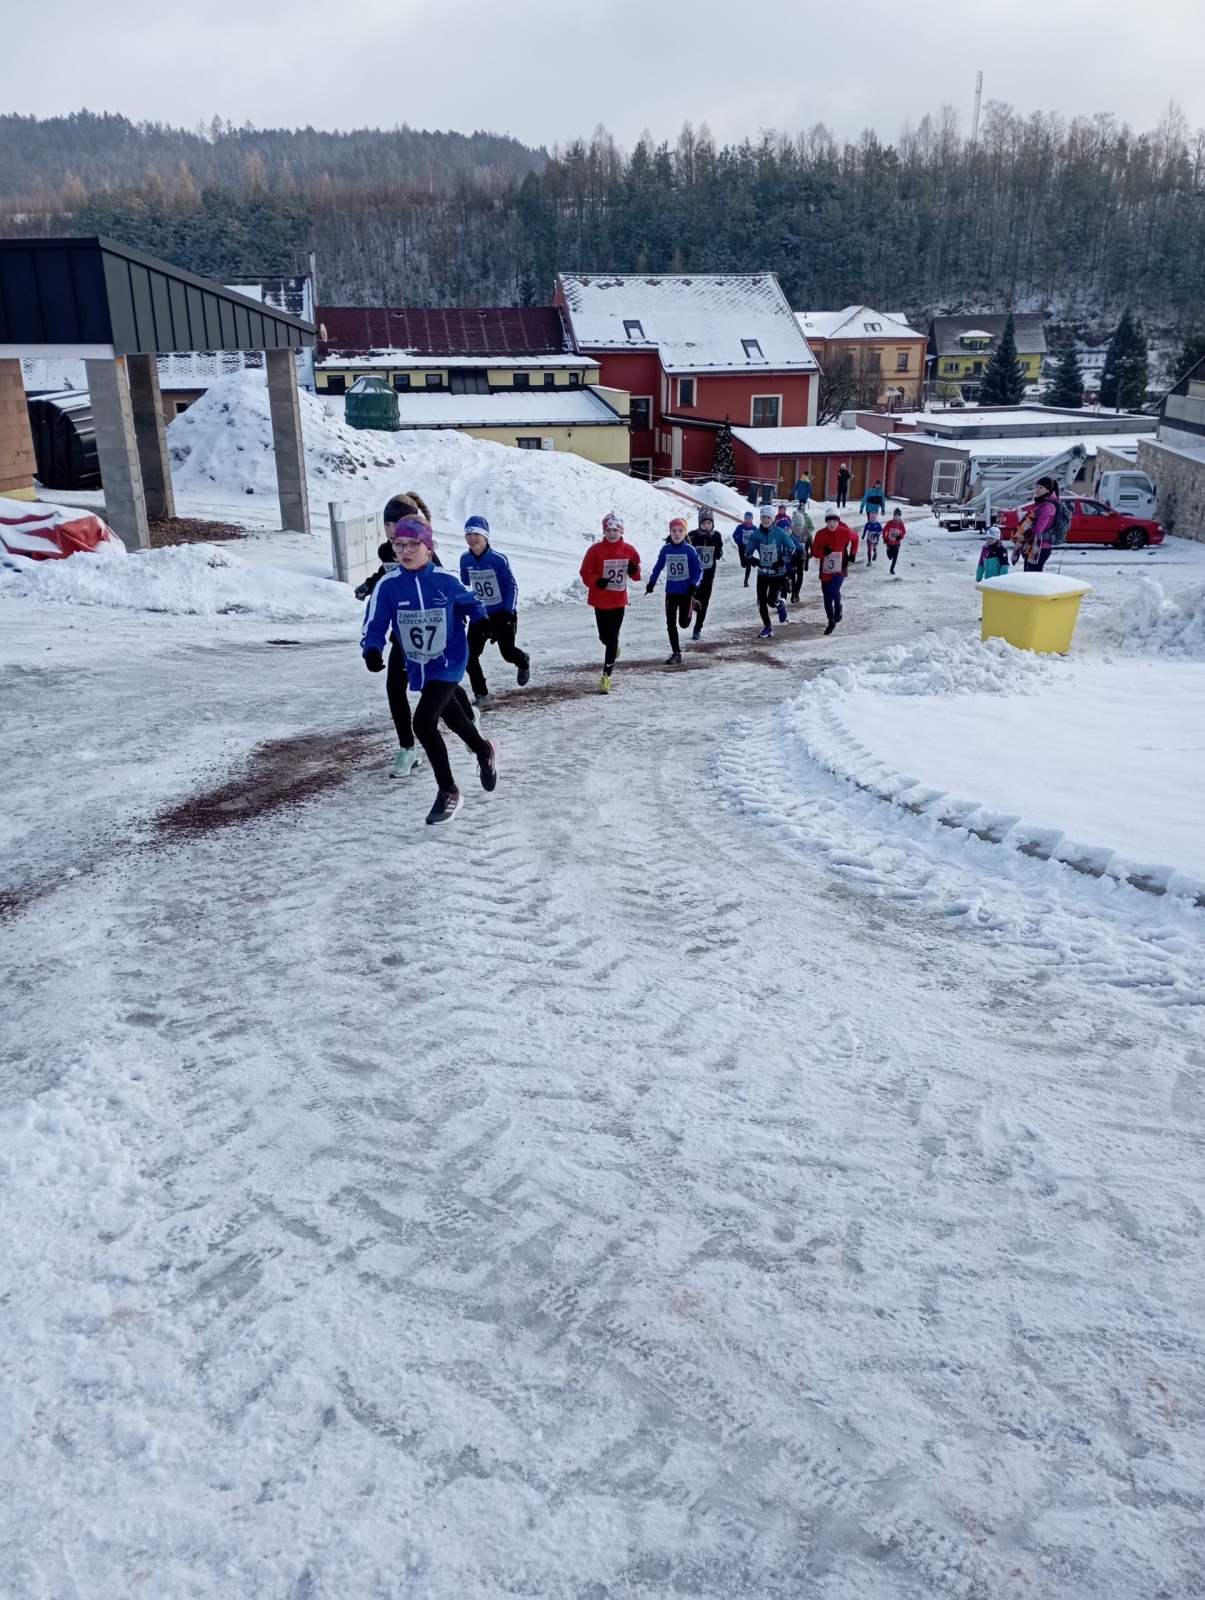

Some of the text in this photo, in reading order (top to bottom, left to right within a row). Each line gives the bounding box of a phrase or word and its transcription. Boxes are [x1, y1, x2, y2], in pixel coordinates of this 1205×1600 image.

[762, 551, 773, 562] 27
[670, 562, 684, 576] 69
[828, 559, 835, 570] 3
[607, 569, 624, 584] 25
[474, 581, 494, 598] 96
[409, 625, 437, 651] 67
